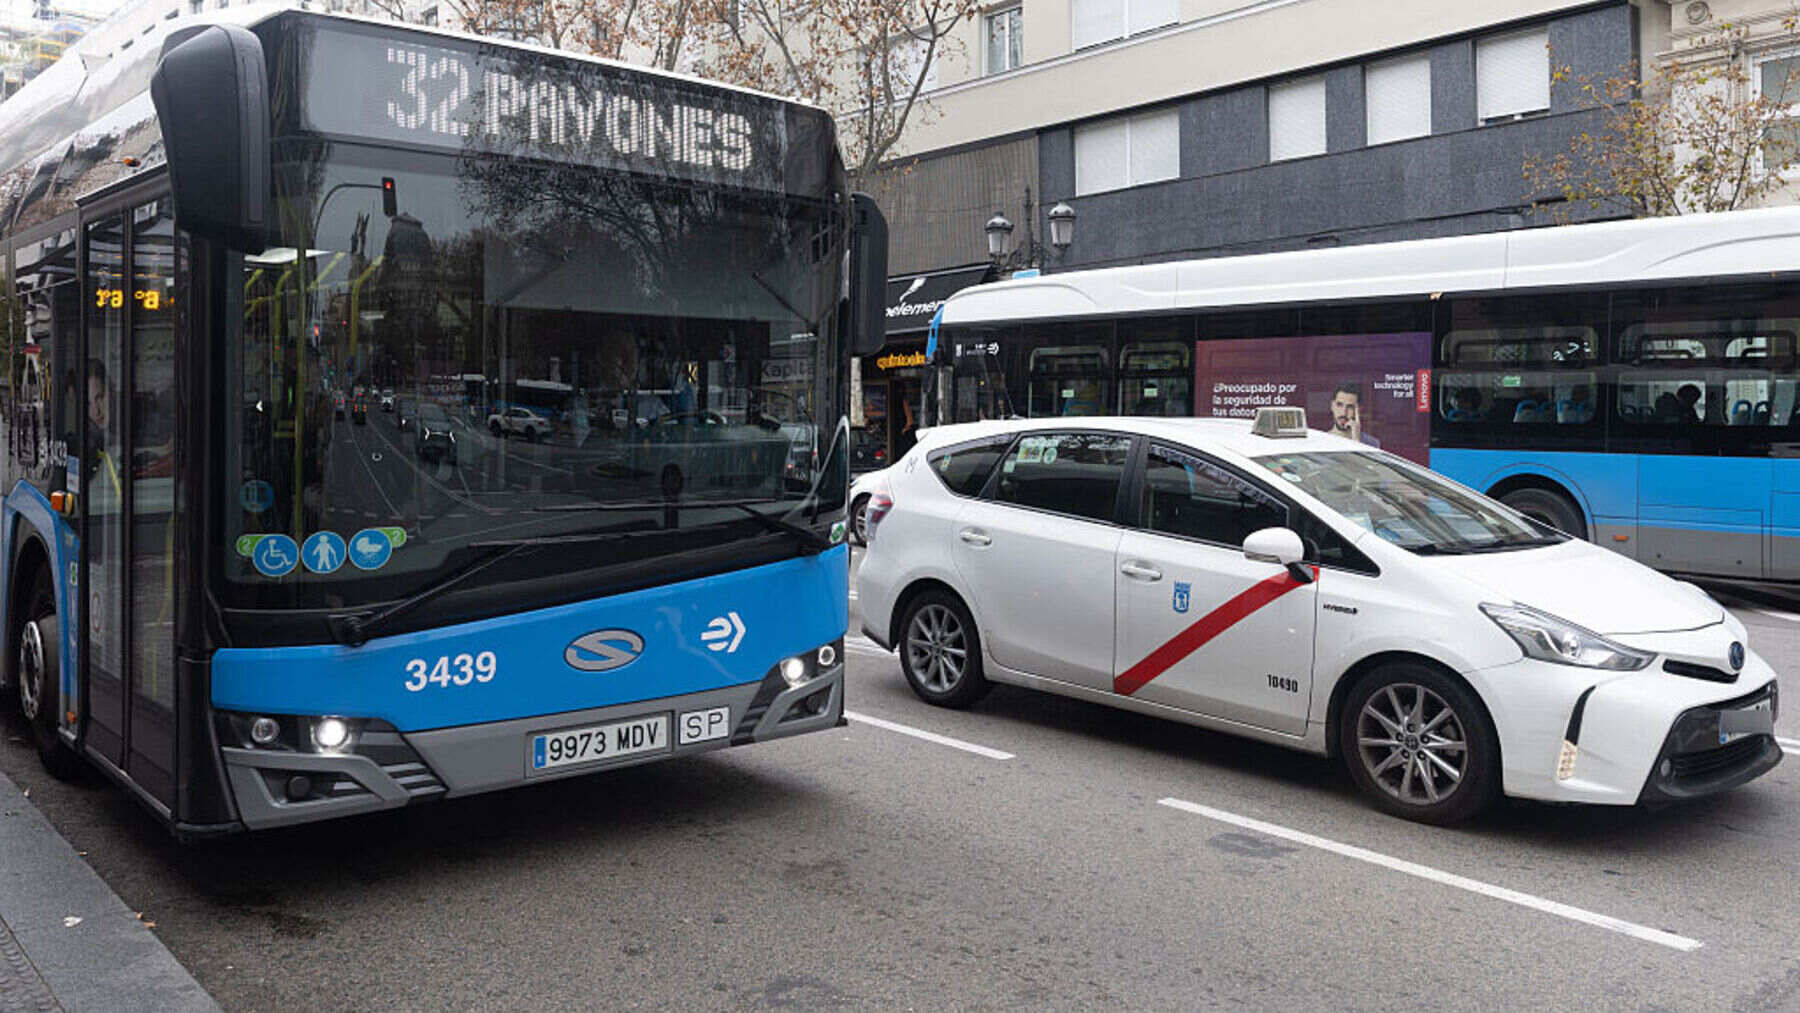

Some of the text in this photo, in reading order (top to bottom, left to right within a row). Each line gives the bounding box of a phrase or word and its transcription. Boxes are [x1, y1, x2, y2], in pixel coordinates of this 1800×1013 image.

[386, 47, 752, 170] 32 PAVONES
[1213, 383, 1297, 394] ¿Preocupado por
[1374, 382, 1414, 391] technology
[1420, 373, 1429, 409] Lenovo
[1212, 395, 1287, 406] la seguridad de
[1212, 407, 1227, 417] tus
[404, 650, 497, 692] 3439
[1266, 674, 1299, 694] 10490
[685, 712, 725, 739] SP
[550, 721, 659, 762] 9973 MDV
